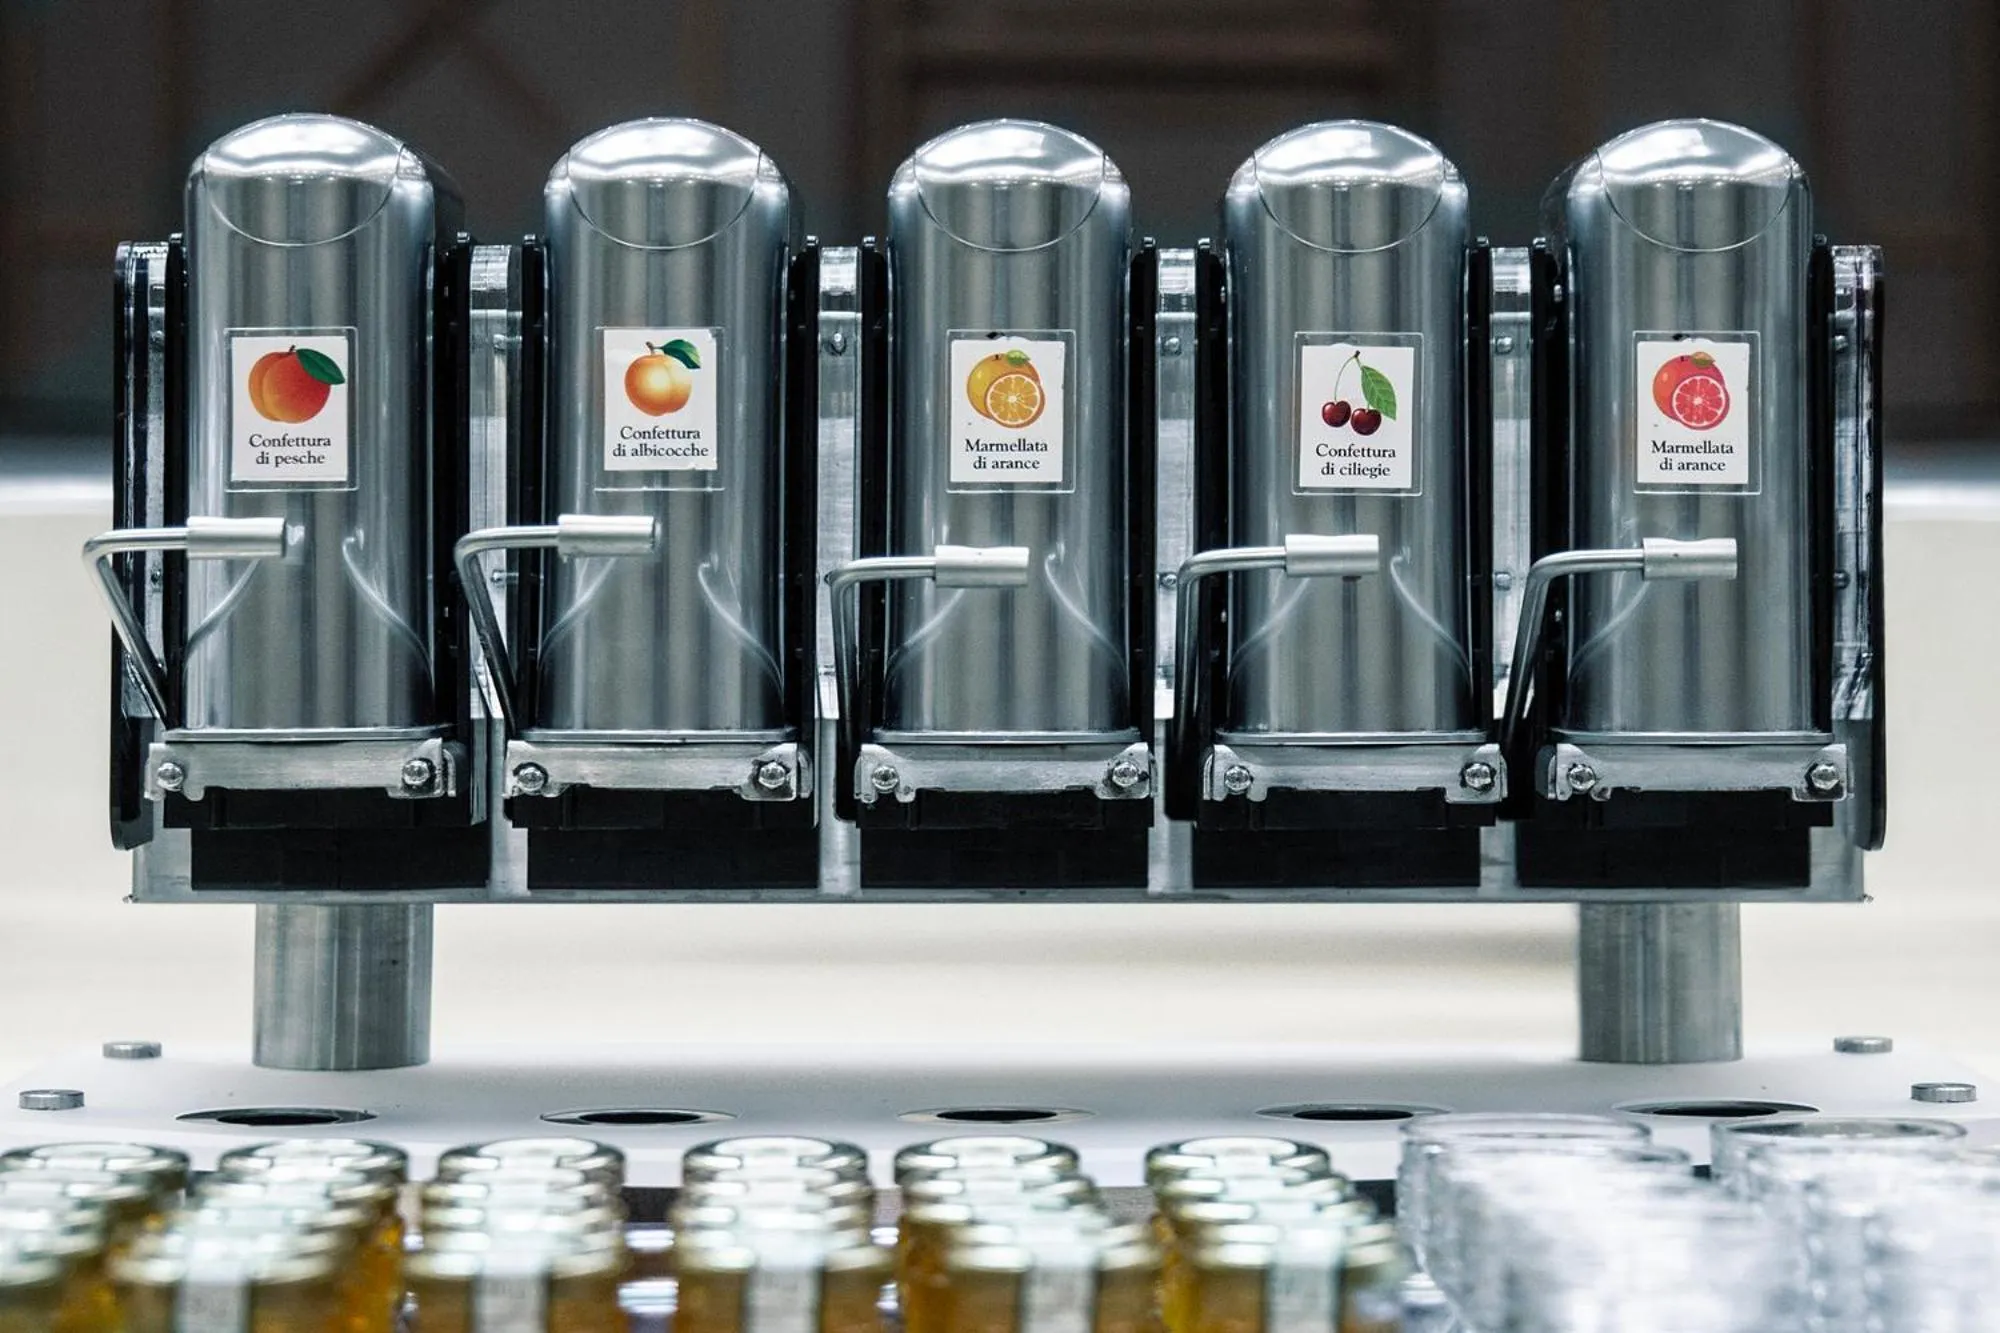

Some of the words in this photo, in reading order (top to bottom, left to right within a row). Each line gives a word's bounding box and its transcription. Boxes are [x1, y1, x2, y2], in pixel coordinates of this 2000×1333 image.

[619, 425, 701, 440] Confettura
[248, 433, 331, 448] Confettura
[964, 438, 1049, 453] Marmellata
[1651, 440, 1735, 454] Marmellata
[612, 442, 627, 457] di
[631, 442, 709, 457] albicocche
[1315, 443, 1397, 458] Confettura
[255, 451, 270, 465] di
[274, 450, 326, 468] pesche
[972, 455, 987, 470] di
[991, 459, 1041, 470] arance
[1659, 457, 1673, 471] di
[1677, 462, 1727, 471] arance
[1320, 461, 1335, 476] di
[1339, 461, 1392, 479] ciliegie
